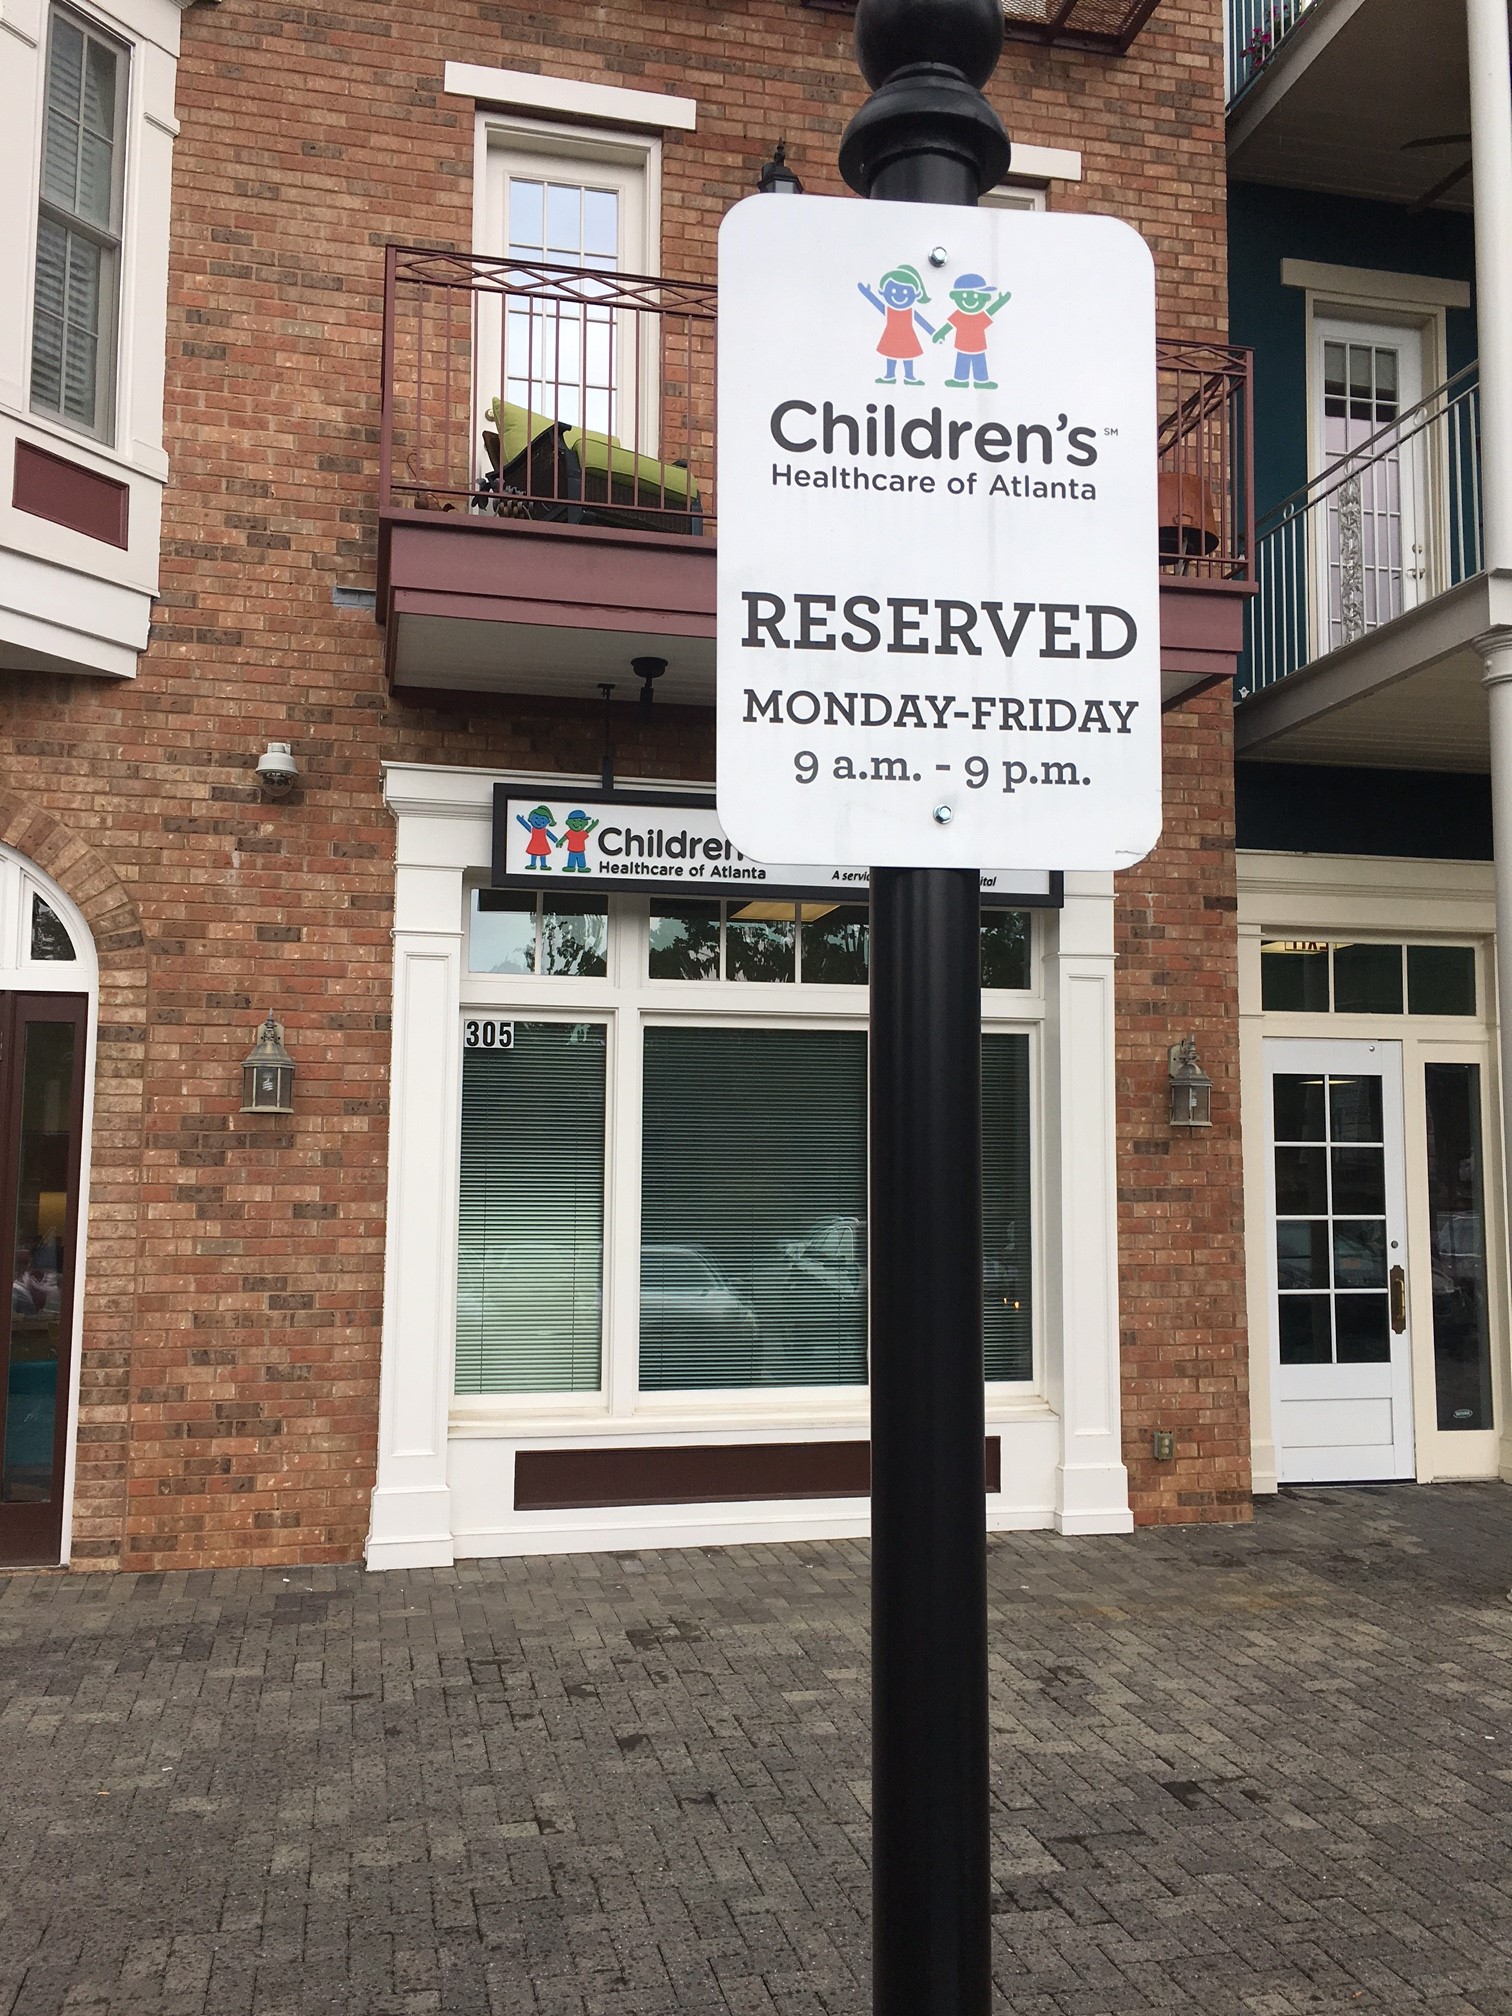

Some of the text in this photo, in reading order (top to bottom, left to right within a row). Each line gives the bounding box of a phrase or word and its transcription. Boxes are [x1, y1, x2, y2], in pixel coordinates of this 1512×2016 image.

[771, 400, 1098, 466] Children's
[772, 464, 1096, 500] Healthcare of Atlanta
[742, 592, 1138, 660] RESERVED
[743, 689, 1139, 734] MONDAY-FRIDAY
[794, 751, 819, 784] 9
[833, 757, 922, 781] a.m.
[965, 756, 989, 789] 9
[1003, 762, 1091, 793] p.m.
[598, 826, 744, 861] Children
[599, 861, 767, 880] Healthcare of Atlanta
[831, 870, 840, 880] A
[842, 871, 870, 882] servic
[466, 1021, 512, 1048] 305
